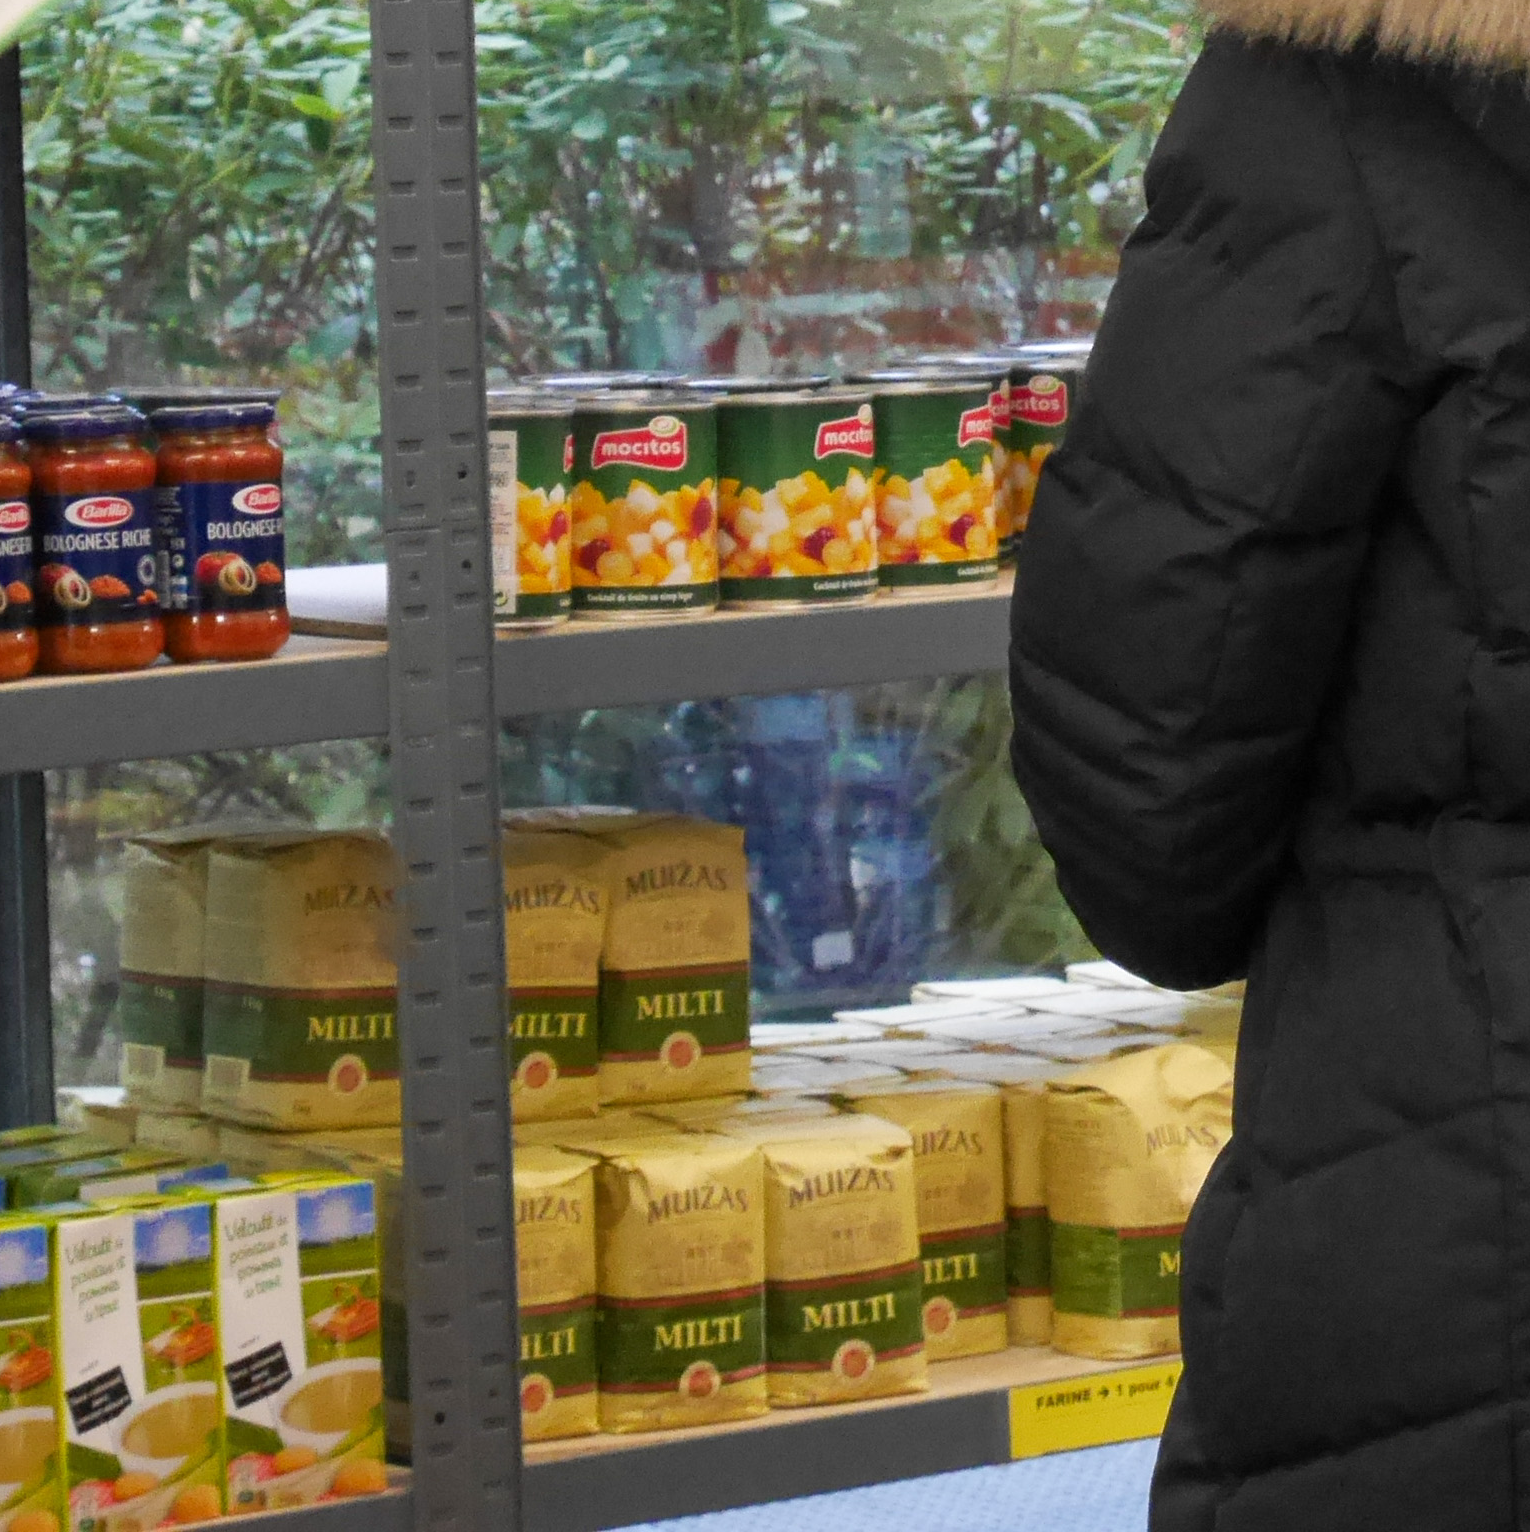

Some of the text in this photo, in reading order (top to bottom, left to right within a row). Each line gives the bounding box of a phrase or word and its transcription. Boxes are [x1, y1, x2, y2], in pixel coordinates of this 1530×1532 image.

[601, 438, 681, 457] mocitos
[82, 503, 128, 519] Barilla
[43, 528, 152, 552] BOLOGNESE RICHE
[207, 520, 276, 540] BOLOGNESE
[625, 863, 729, 902] MUIŽAS
[636, 987, 725, 1022] MILTI
[307, 1011, 394, 1042] MILTI
[786, 1166, 896, 1210] MUIŽAS
[647, 1185, 749, 1225] MUIŽAS
[921, 1253, 980, 1285] ILTI
[802, 1293, 896, 1335] MILTI
[519, 1327, 577, 1362] ILTI
[654, 1313, 744, 1353] MILTI
[1036, 1387, 1092, 1409] FARINE
[1129, 1379, 1161, 1397] pour
